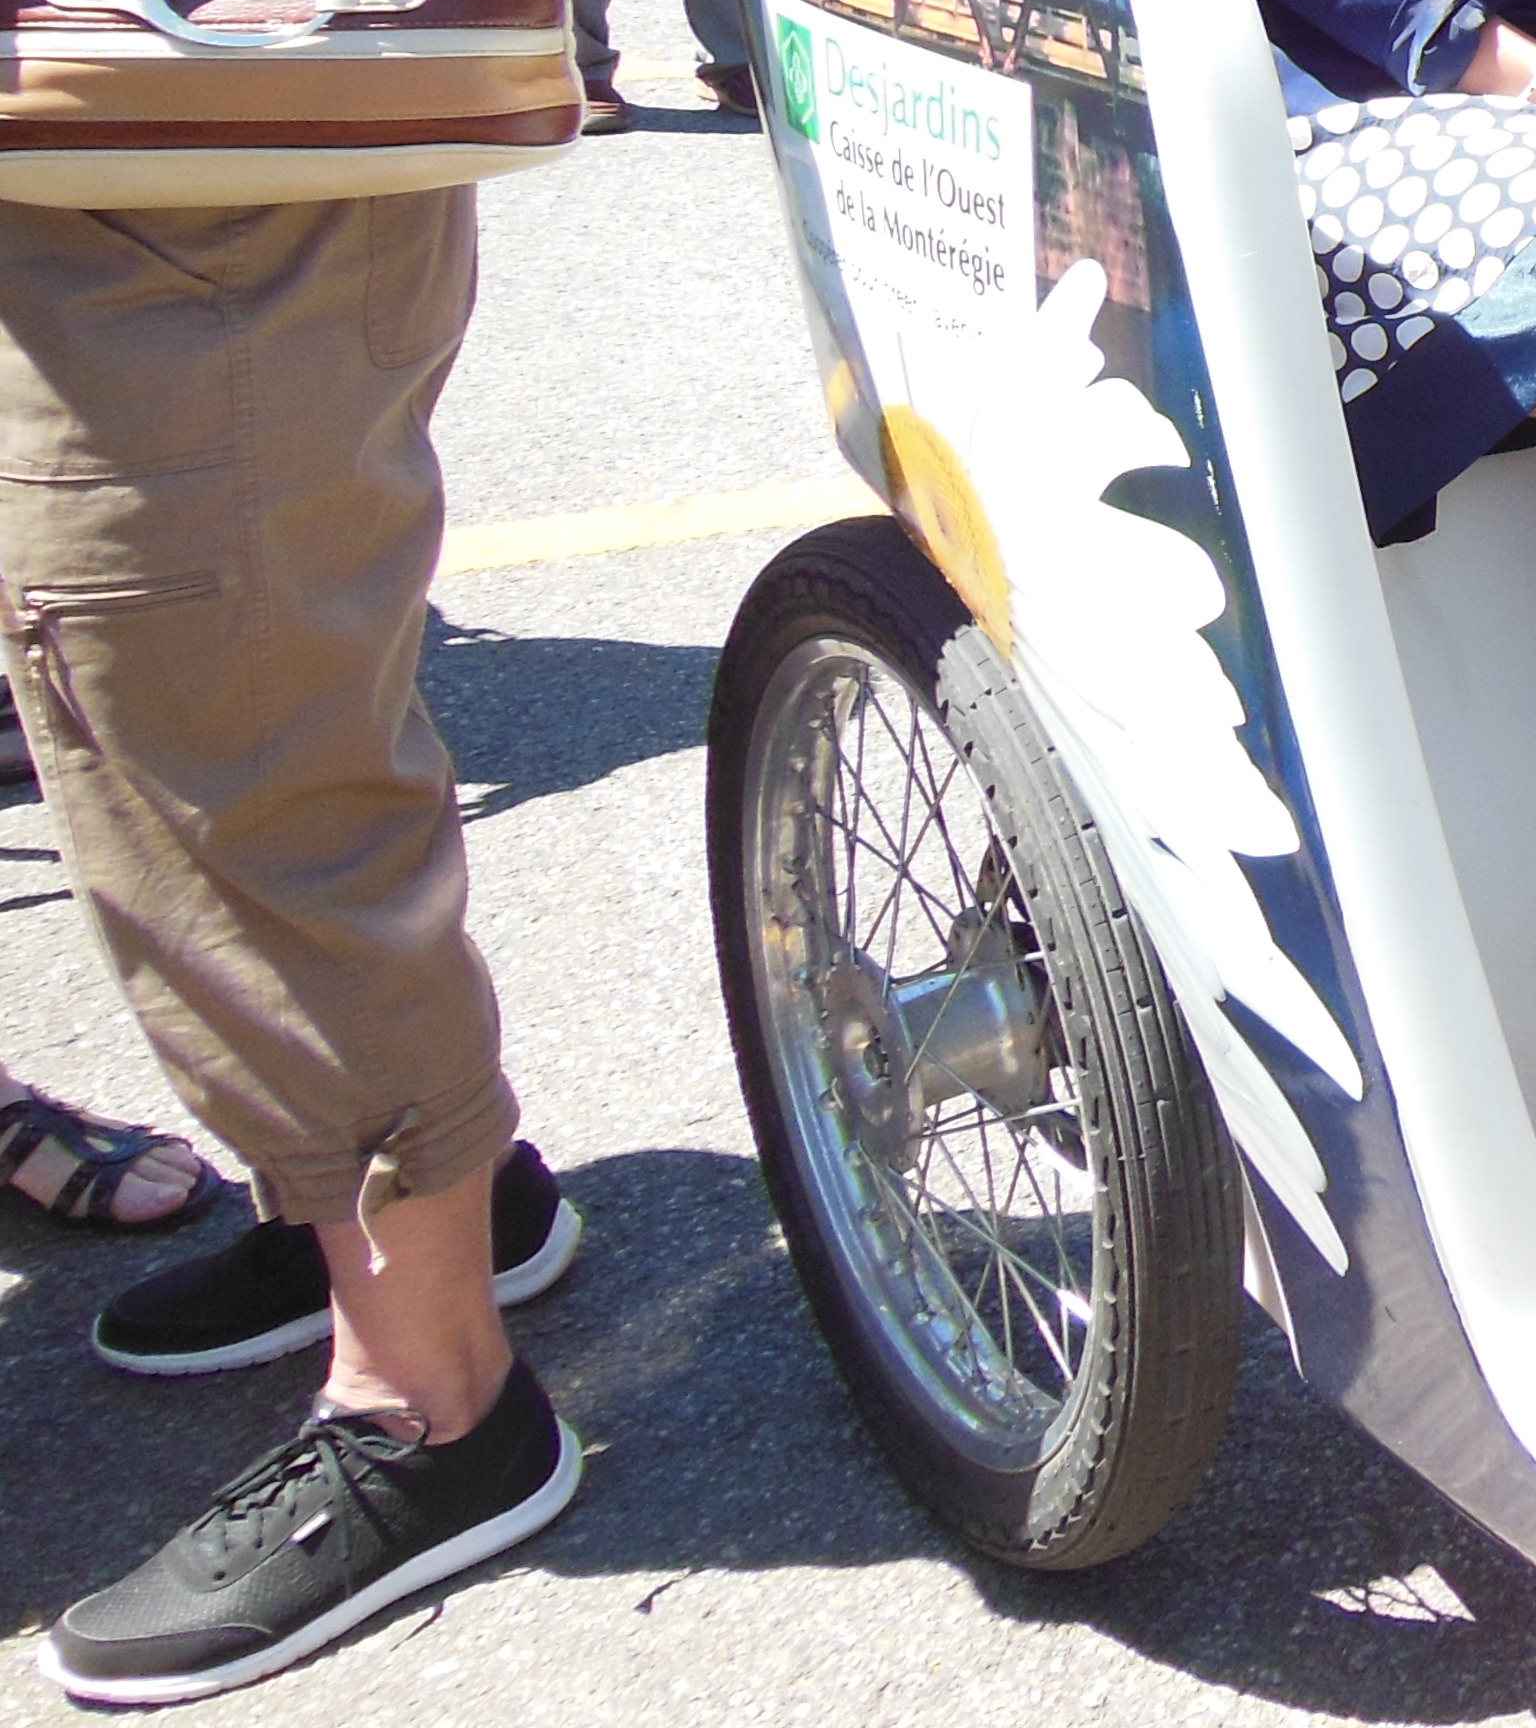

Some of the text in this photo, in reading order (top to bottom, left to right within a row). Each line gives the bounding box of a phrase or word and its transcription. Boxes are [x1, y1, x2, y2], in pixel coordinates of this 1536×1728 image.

[825, 36, 1001, 161] Desjardins
[829, 120, 1006, 230] Caisse de l'Ouest
[836, 178, 856, 222] de
[861, 189, 877, 233] la
[883, 206, 1006, 296] Montérégie
